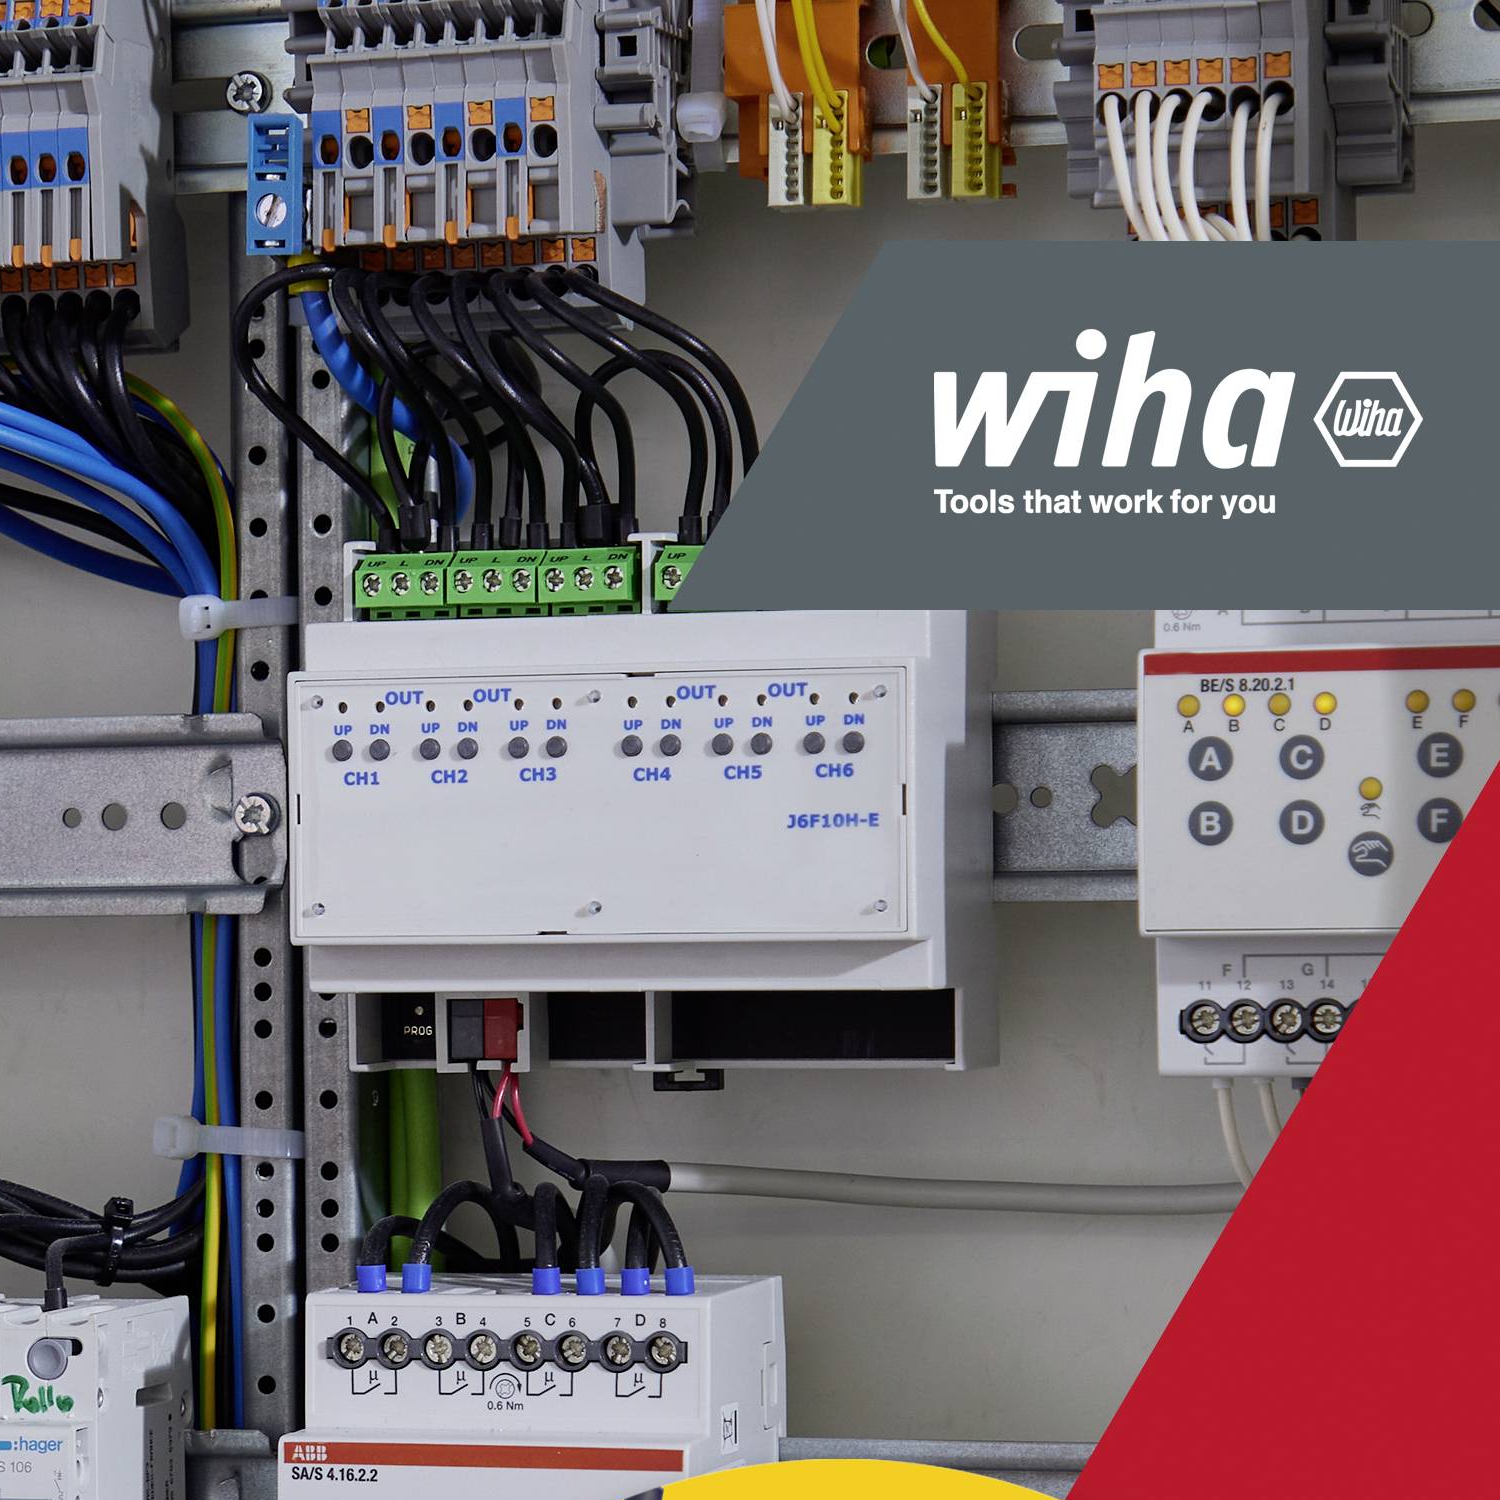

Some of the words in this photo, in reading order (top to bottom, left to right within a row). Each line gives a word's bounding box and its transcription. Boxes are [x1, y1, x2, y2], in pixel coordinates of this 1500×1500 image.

[768, 683, 807, 697] OUT
[1200, 678, 1235, 693] BE/S
[1238, 677, 1295, 692] 8.20.2.1
[385, 690, 424, 706] OUT
[473, 688, 512, 704] OUT
[676, 685, 715, 700] OUT
[510, 720, 529, 732] UP
[546, 719, 567, 731] DN
[623, 720, 643, 731] UP
[661, 719, 681, 730] DN
[713, 717, 733, 729] UP
[752, 716, 772, 728] DN
[805, 715, 825, 727] UP
[844, 714, 865, 726] DN
[1183, 720, 1195, 733] A
[1229, 719, 1239, 732] B
[1274, 719, 1285, 732] C
[1320, 718, 1331, 731] D
[1412, 716, 1422, 729] E
[1459, 716, 1468, 729] F
[334, 725, 352, 736] UP
[370, 724, 390, 735] DN
[421, 722, 440, 734] UP
[458, 721, 478, 733] DN
[1199, 747, 1222, 771] A
[1290, 745, 1314, 769] C
[1431, 743, 1449, 766] E
[431, 769, 468, 784] CH2
[519, 767, 557, 782] CH3
[633, 767, 671, 781] CH4
[723, 765, 762, 780] CH5
[815, 763, 854, 778] CH6
[343, 772, 380, 786] CH1
[786, 813, 880, 829] J6F10H-E
[1202, 811, 1222, 835] B
[1292, 811, 1312, 835] D
[1432, 808, 1448, 832] F
[1223, 964, 1232, 976] F
[1302, 963, 1314, 976] G
[1199, 981, 1212, 990] 11
[1237, 981, 1252, 990] 12
[1280, 980, 1294, 990] 13
[1320, 979, 1335, 990] 14
[403, 1026, 433, 1036] PROG
[487, 1401, 504, 1411] 0.6
[506, 1401, 524, 1411] Nm
[292, 1444, 327, 1461] ABB
[9, 1461, 32, 1474] 106
[291, 1466, 324, 1481] SA/S
[326, 1467, 378, 1482] 4.16.2.2
